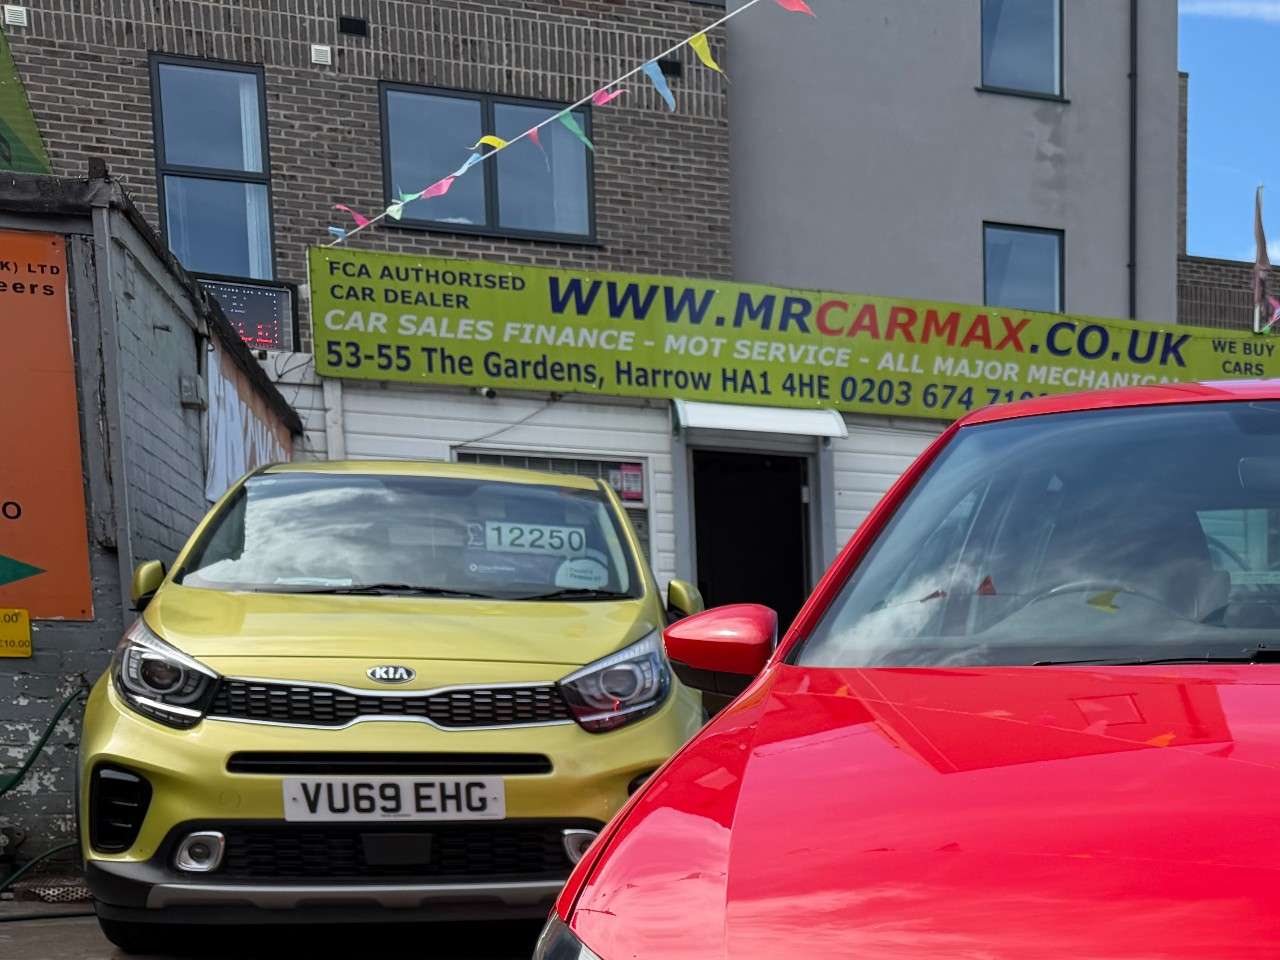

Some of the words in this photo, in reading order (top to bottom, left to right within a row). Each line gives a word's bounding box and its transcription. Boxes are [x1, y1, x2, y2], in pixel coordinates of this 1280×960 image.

[28, 263, 60, 275] LTD
[328, 261, 372, 279] FCA
[379, 265, 526, 291] AUTHORISED
[330, 284, 376, 302] CAR
[384, 288, 470, 309] DEALER
[548, 276, 1193, 368] WWW.MRCARMAX.CO.UK
[324, 309, 388, 334] CAR
[398, 313, 494, 341] SALES
[503, 322, 635, 351] FINANCE
[664, 334, 727, 358] MOT
[733, 339, 851, 368] SERVICE
[877, 352, 924, 374] ALL
[933, 355, 1019, 382] MAJOR
[1027, 363, 1181, 388] MECHANI
[1212, 338, 1237, 354] WE
[1243, 342, 1275, 357] BUY
[326, 340, 412, 372] 53-55
[421, 346, 474, 376] The
[483, 351, 604, 390] Gardens,
[615, 360, 712, 392] Harrow
[722, 367, 773, 395] HA1
[782, 372, 830, 400] 4HE
[840, 376, 913, 406] 0203
[922, 383, 974, 411] 674
[986, 388, 1048, 406] 71
[1222, 360, 1264, 376] CARS
[491, 526, 584, 552] 12250
[375, 666, 409, 680] KIA
[300, 782, 402, 814] VU69
[413, 781, 488, 813] EHG
